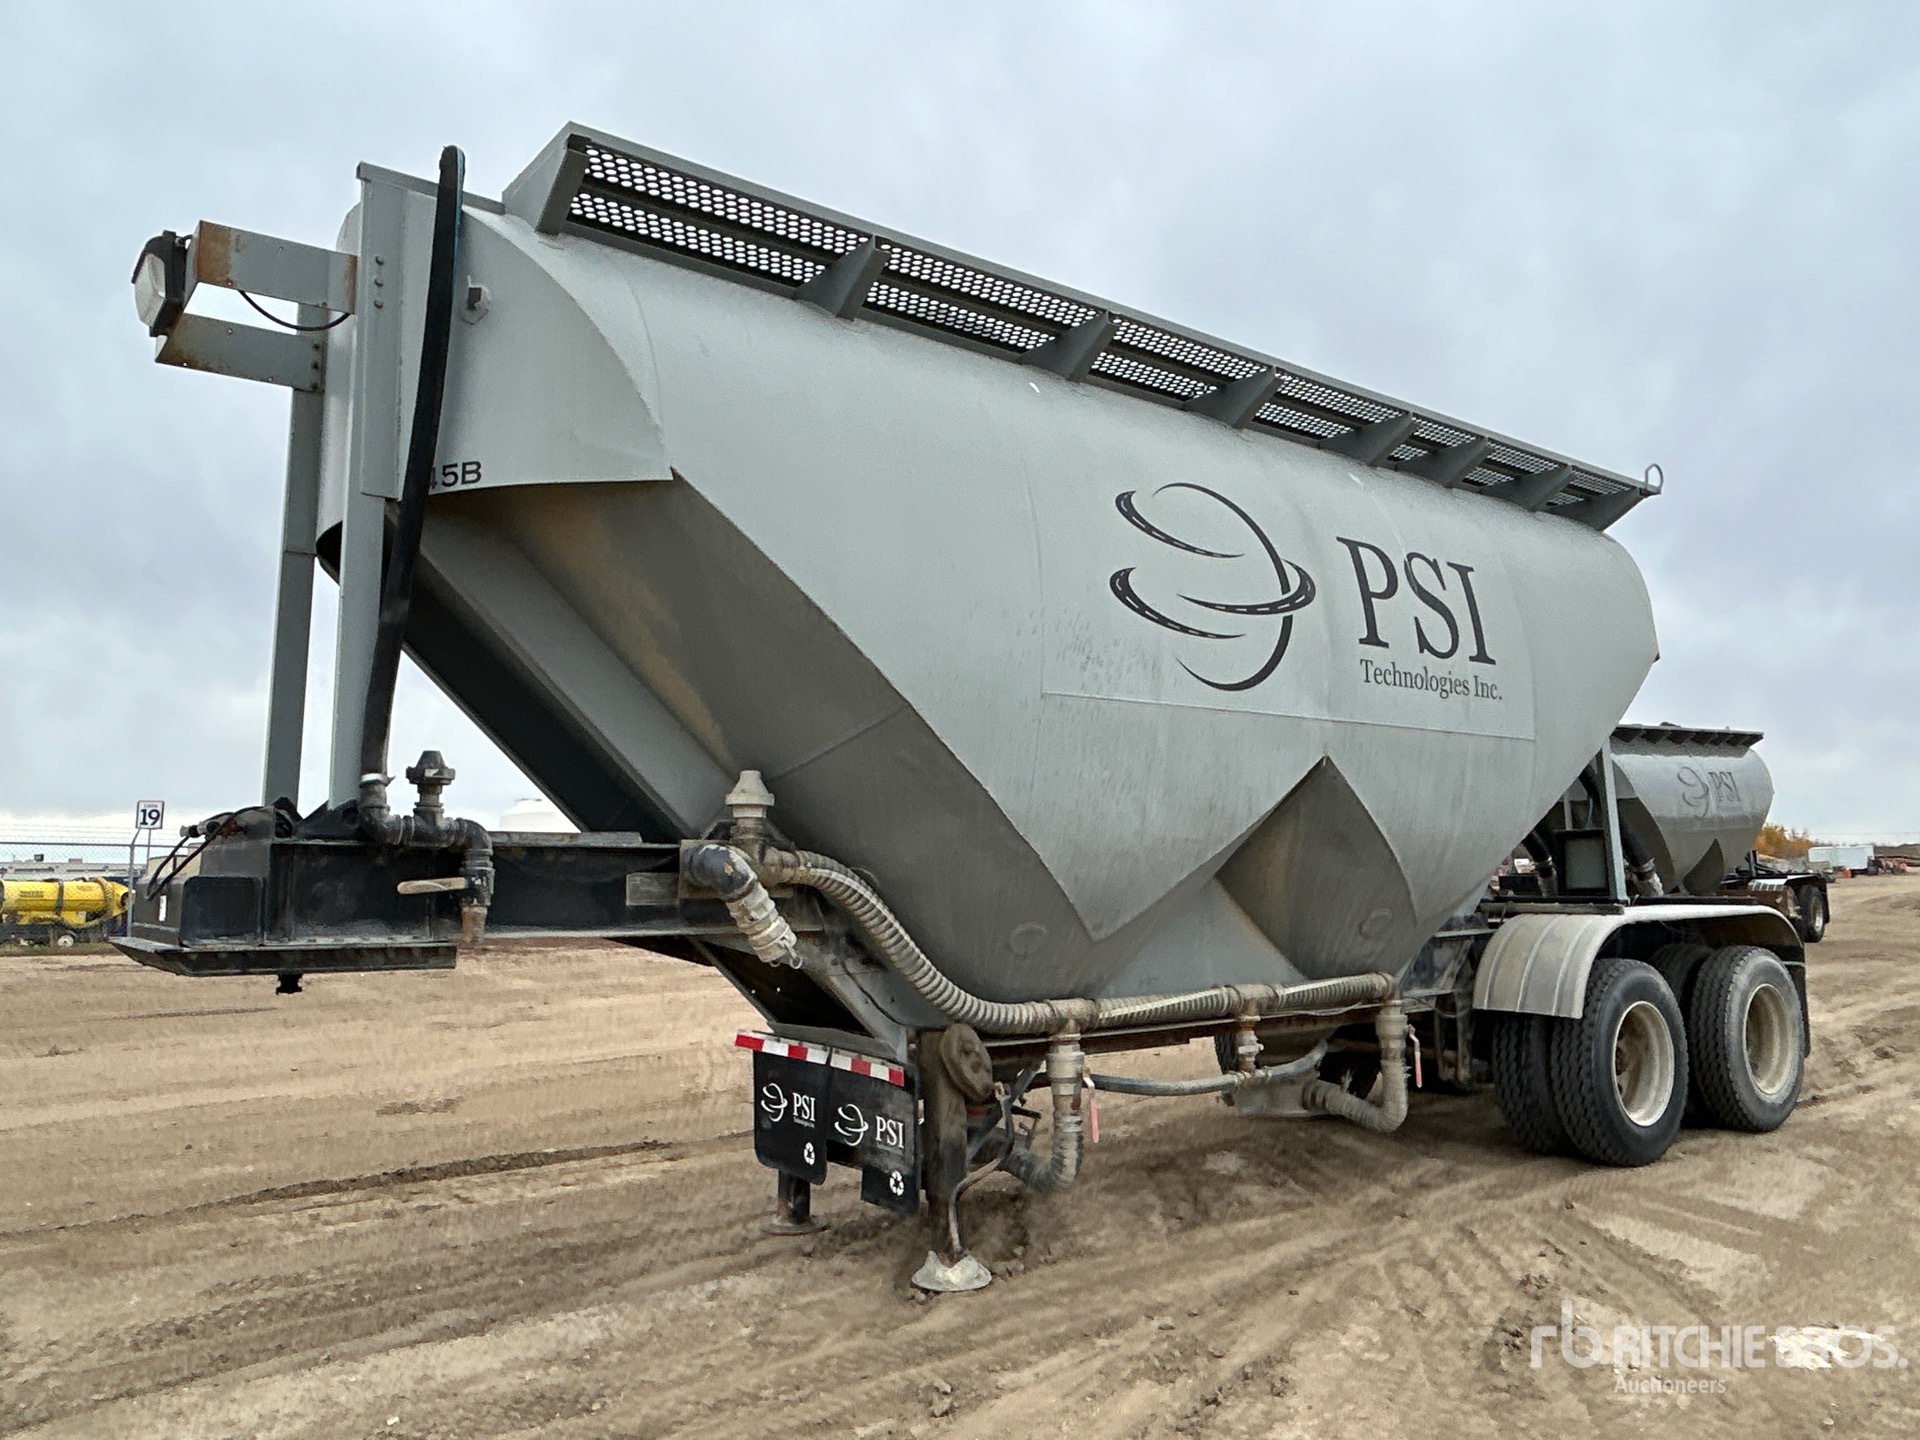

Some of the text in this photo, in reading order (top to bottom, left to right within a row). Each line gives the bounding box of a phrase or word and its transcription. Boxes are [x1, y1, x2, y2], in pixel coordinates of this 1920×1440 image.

[1336, 536, 1496, 665] PSI
[1360, 659, 1502, 700] Technologies Inc.
[140, 808, 160, 826] 19
[792, 1092, 816, 1122] PSI
[875, 1116, 905, 1149] PSI
